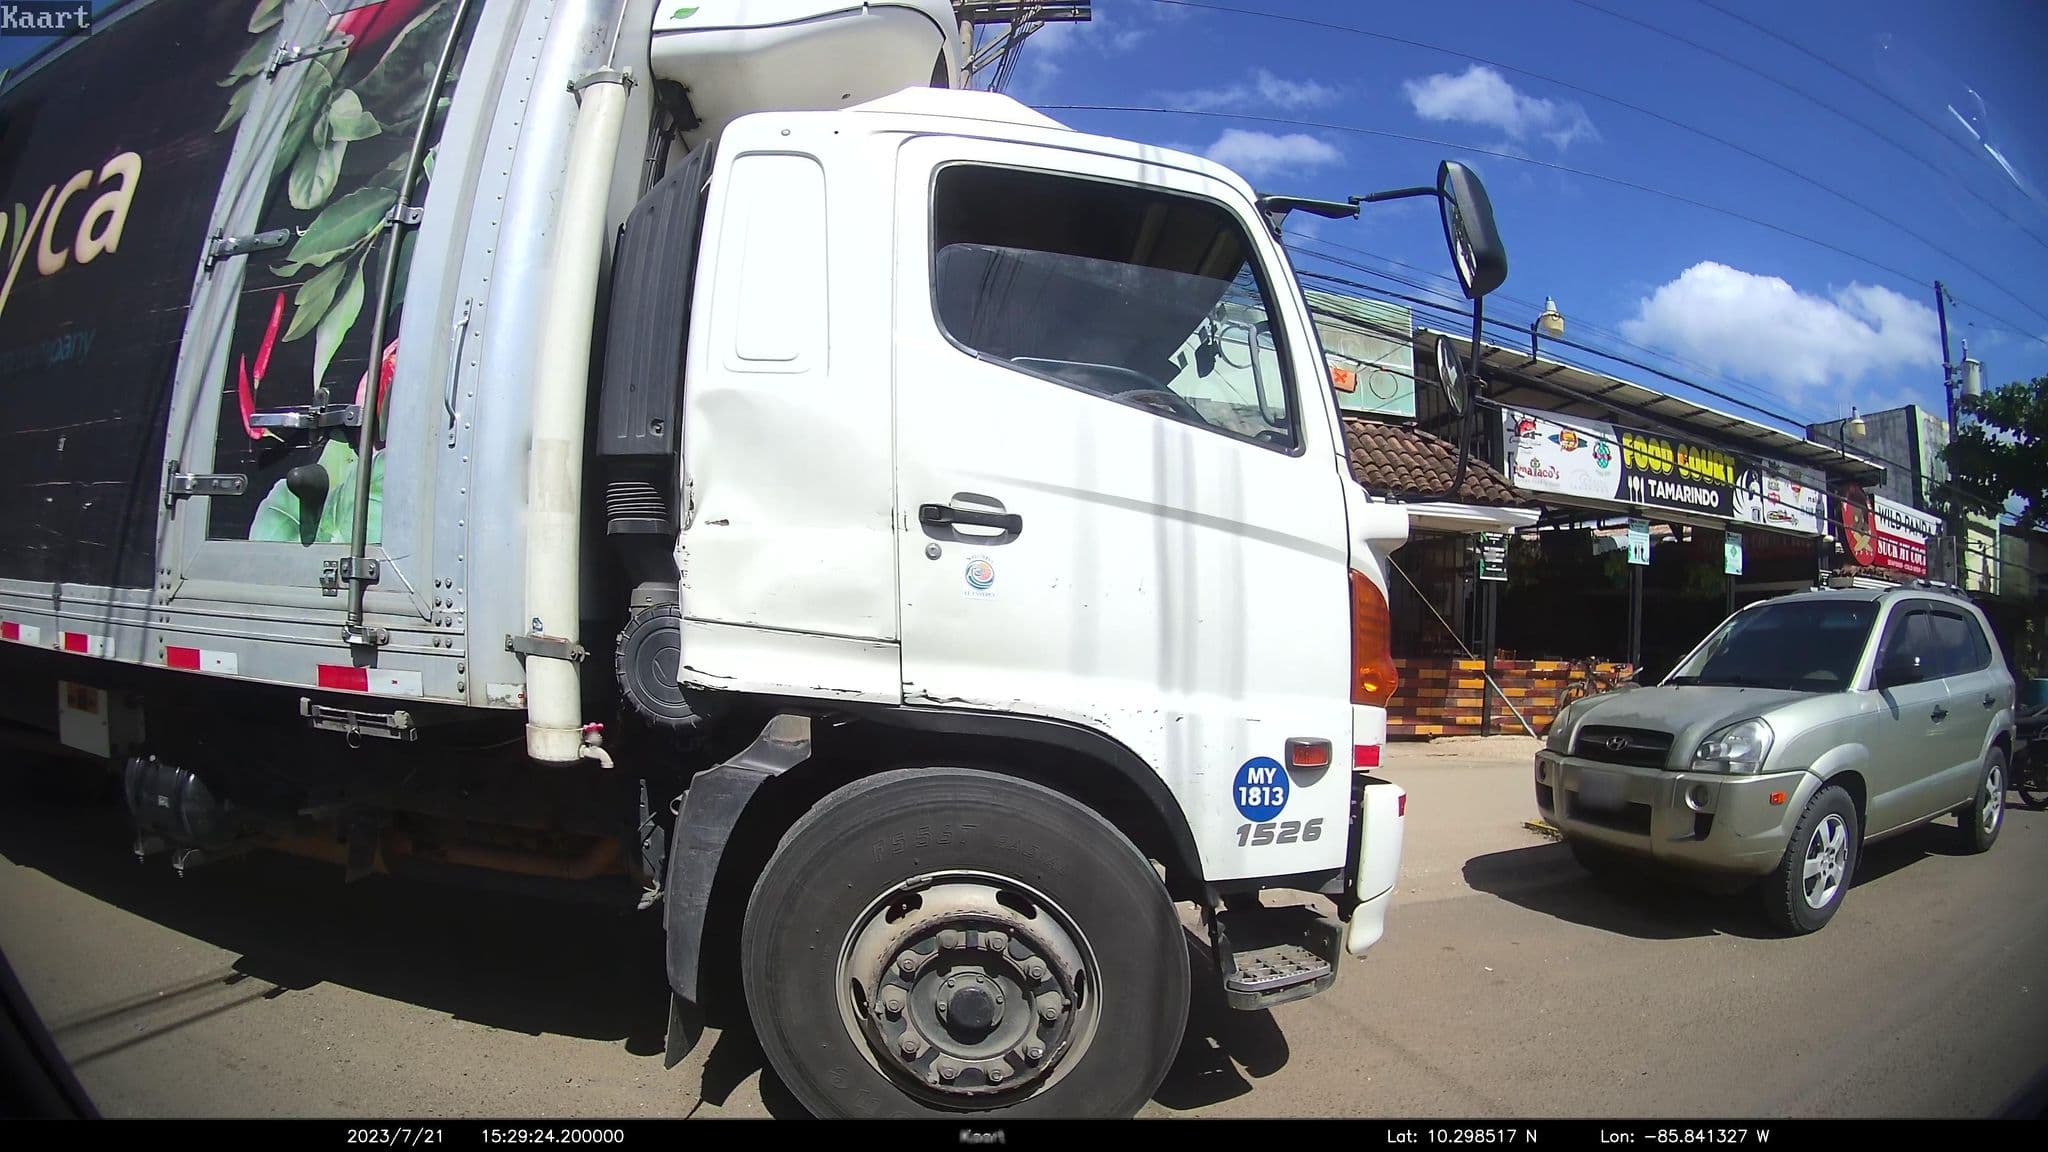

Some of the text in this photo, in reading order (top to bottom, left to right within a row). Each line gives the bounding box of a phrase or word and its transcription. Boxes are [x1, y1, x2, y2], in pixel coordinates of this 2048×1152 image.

[1622, 432, 1736, 488] FOOD COURT
[1648, 479, 1719, 508] TAMARINDO
[1879, 505, 1901, 530] WILD
[1247, 767, 1277, 785] MY
[1238, 786, 1284, 806] 1813
[1236, 818, 1324, 847] 1526
